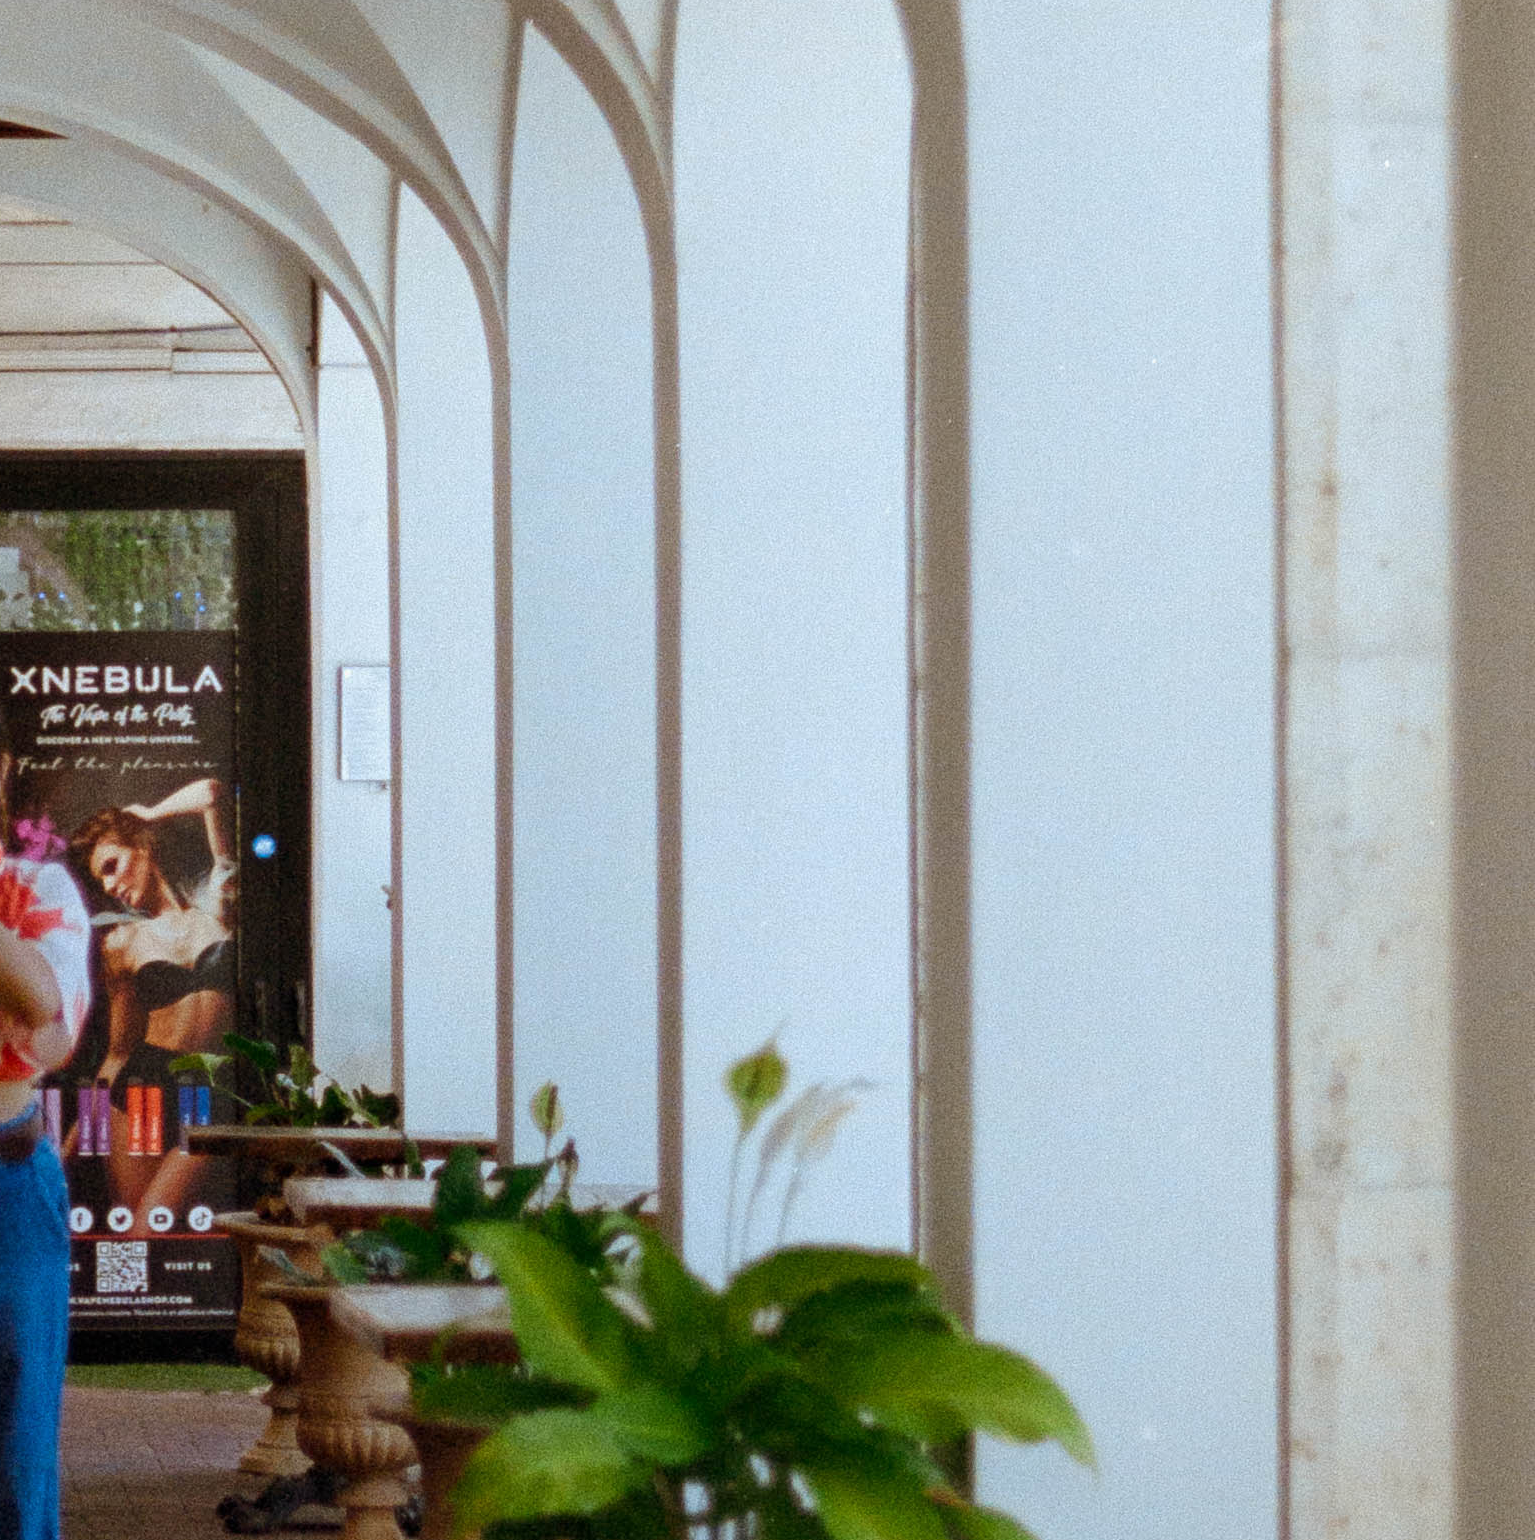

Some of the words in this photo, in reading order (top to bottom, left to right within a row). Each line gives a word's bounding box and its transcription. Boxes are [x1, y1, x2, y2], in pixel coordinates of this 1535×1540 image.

[11, 665, 223, 694] XNEBULA
[40, 704, 67, 729] The
[113, 705, 130, 726] of
[129, 704, 149, 723] the
[36, 736, 81, 745] DISCOVER
[82, 737, 90, 745] A
[91, 736, 112, 745] NEW
[73, 756, 112, 770] the
[164, 1262, 194, 1271] VISIT
[196, 1262, 212, 1271] US
